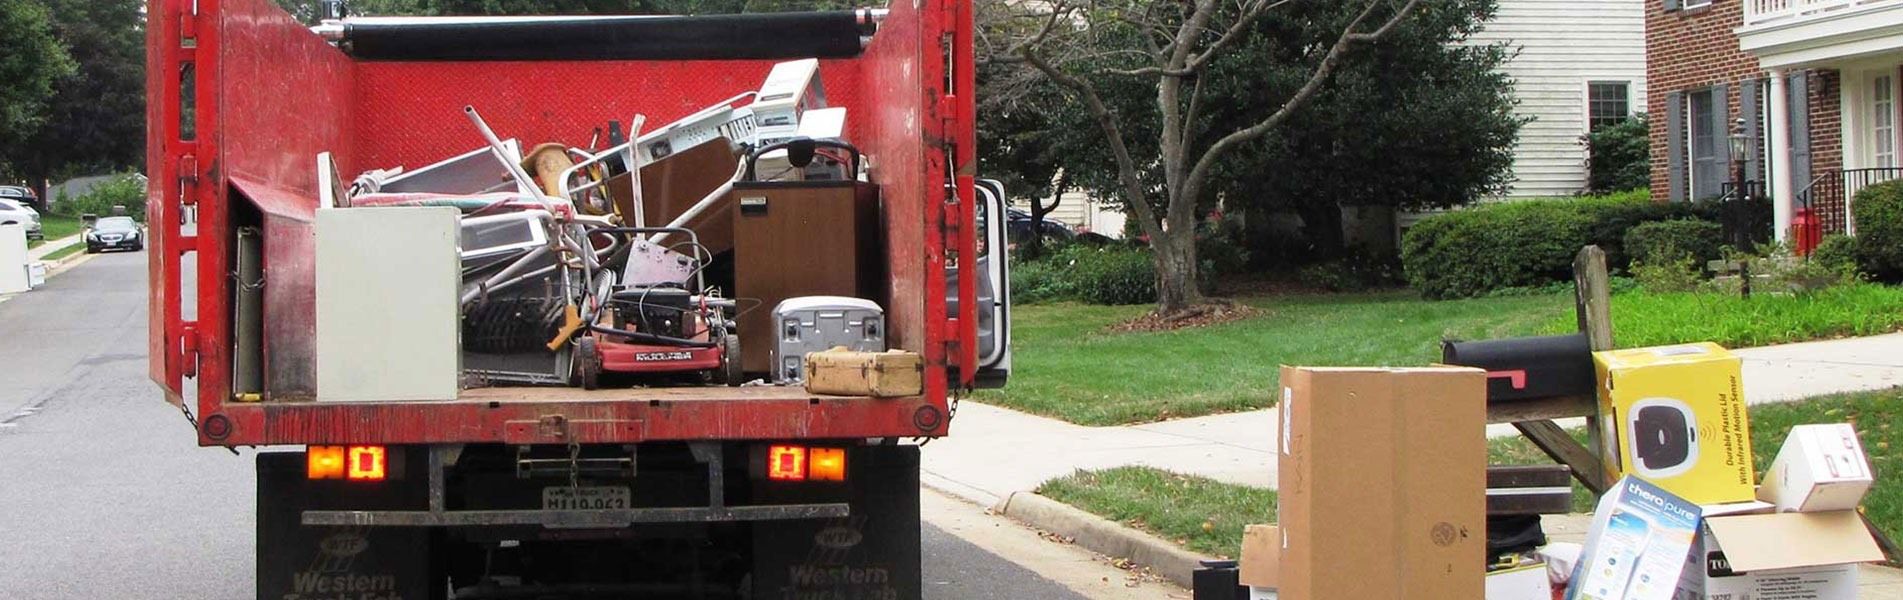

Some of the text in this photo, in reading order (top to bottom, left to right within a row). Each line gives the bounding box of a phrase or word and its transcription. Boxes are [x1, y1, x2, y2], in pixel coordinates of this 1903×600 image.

[1718, 393, 1734, 466] Durable Plastic Lid
[1730, 375, 1748, 485] With Infrared Motion Sensor
[789, 563, 889, 585] Western
[1709, 559, 1731, 571] TO
[293, 571, 396, 593] Western
